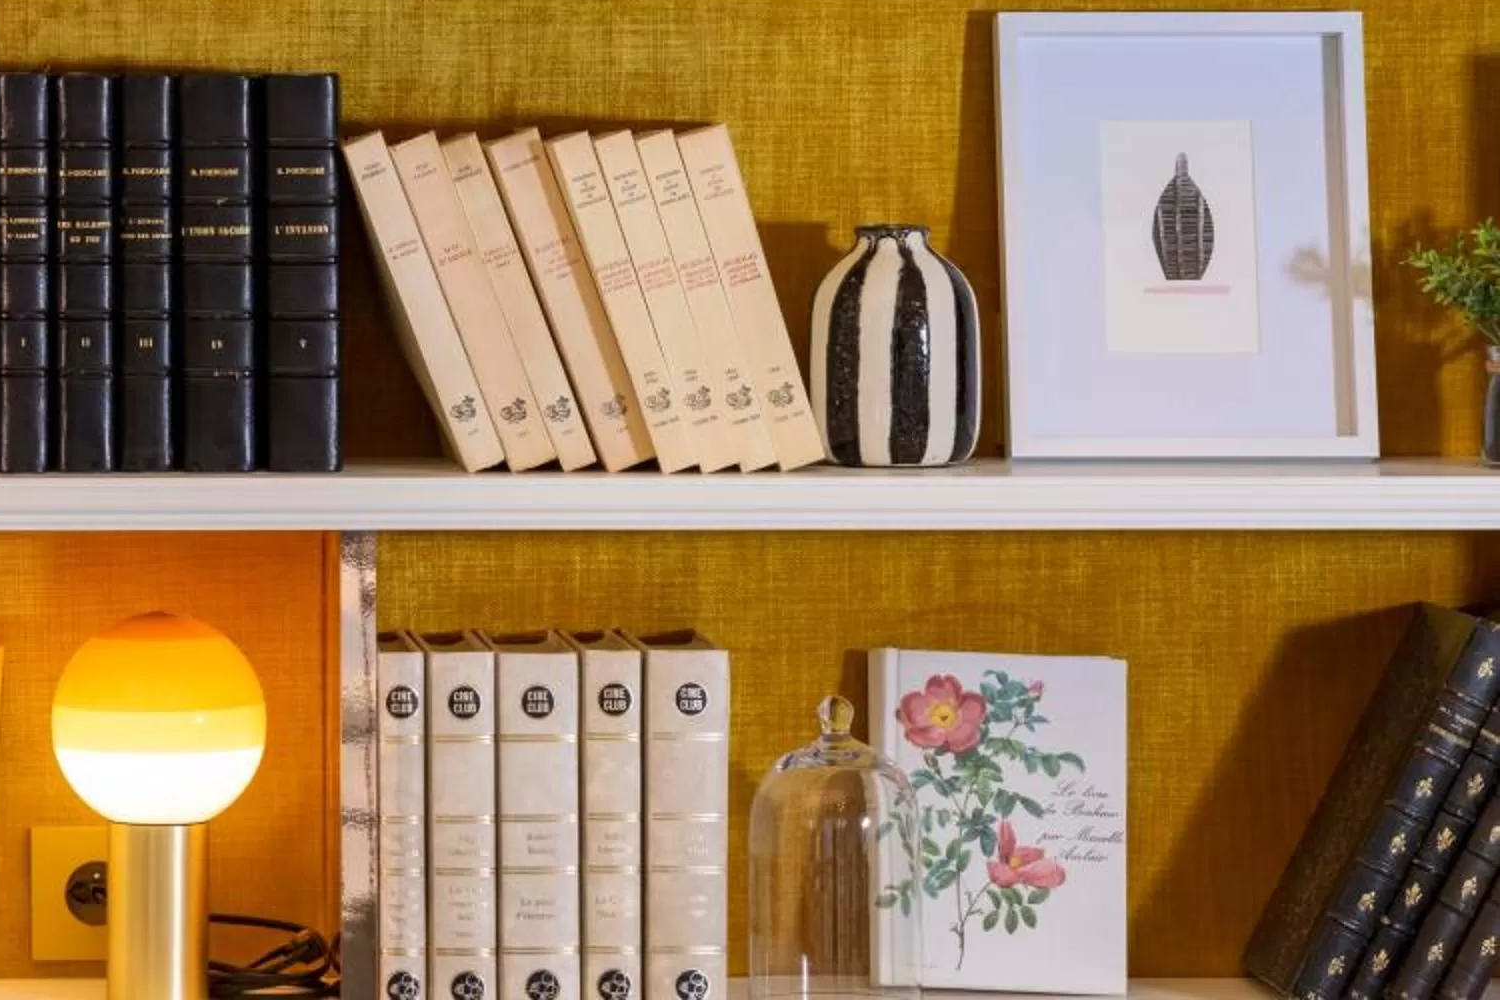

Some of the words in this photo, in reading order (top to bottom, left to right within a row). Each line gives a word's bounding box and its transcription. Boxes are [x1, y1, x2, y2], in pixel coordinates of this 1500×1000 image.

[390, 690, 412, 701] CINE
[453, 690, 475, 701] CINE
[526, 690, 549, 701] CINE
[603, 687, 627, 699] CINE
[679, 687, 704, 699] CINE
[390, 703, 413, 713] CLUB
[453, 703, 477, 713] CLUB
[526, 703, 550, 713] CLUB
[603, 699, 628, 711] CLUB
[679, 699, 703, 711] CLUB
